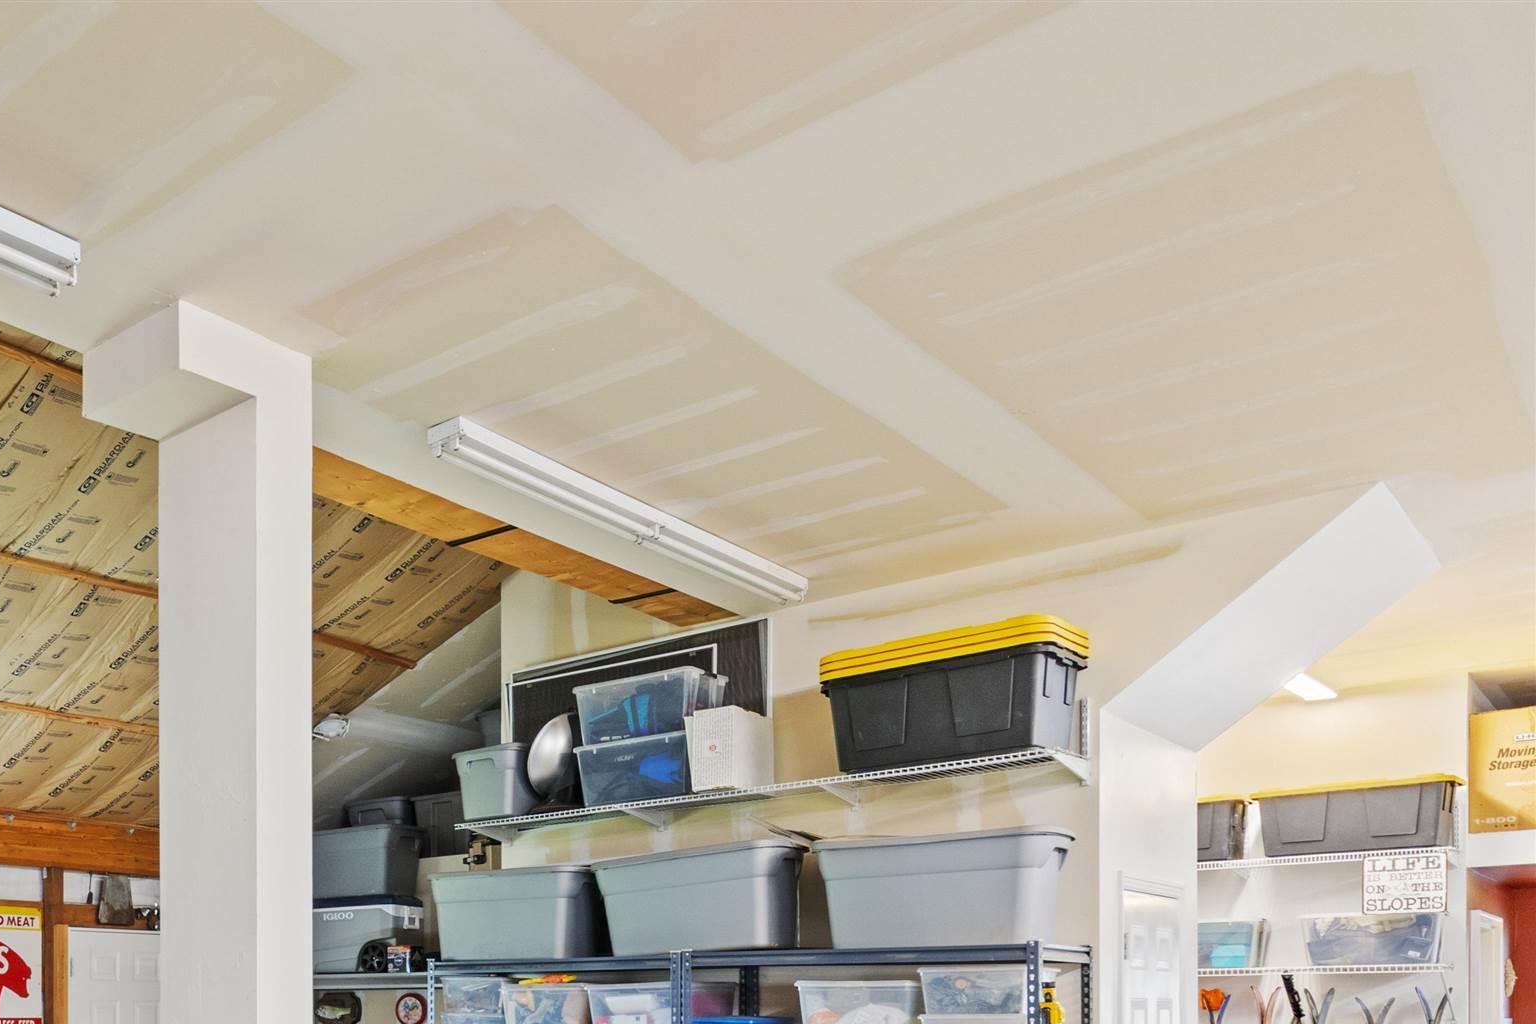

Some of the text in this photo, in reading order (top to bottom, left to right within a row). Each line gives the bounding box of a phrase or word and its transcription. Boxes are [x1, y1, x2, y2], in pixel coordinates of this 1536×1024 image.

[24, 511, 64, 548] GUARDIAN
[1497, 745, 1536, 759] Movin
[1367, 855, 1441, 872] LIFE
[1390, 871, 1443, 881] BETTER
[1366, 881, 1443, 894] ON THE
[1366, 895, 1444, 912] SLOPES
[7, 916, 36, 927] MEAT
[323, 911, 354, 921] IGLOO
